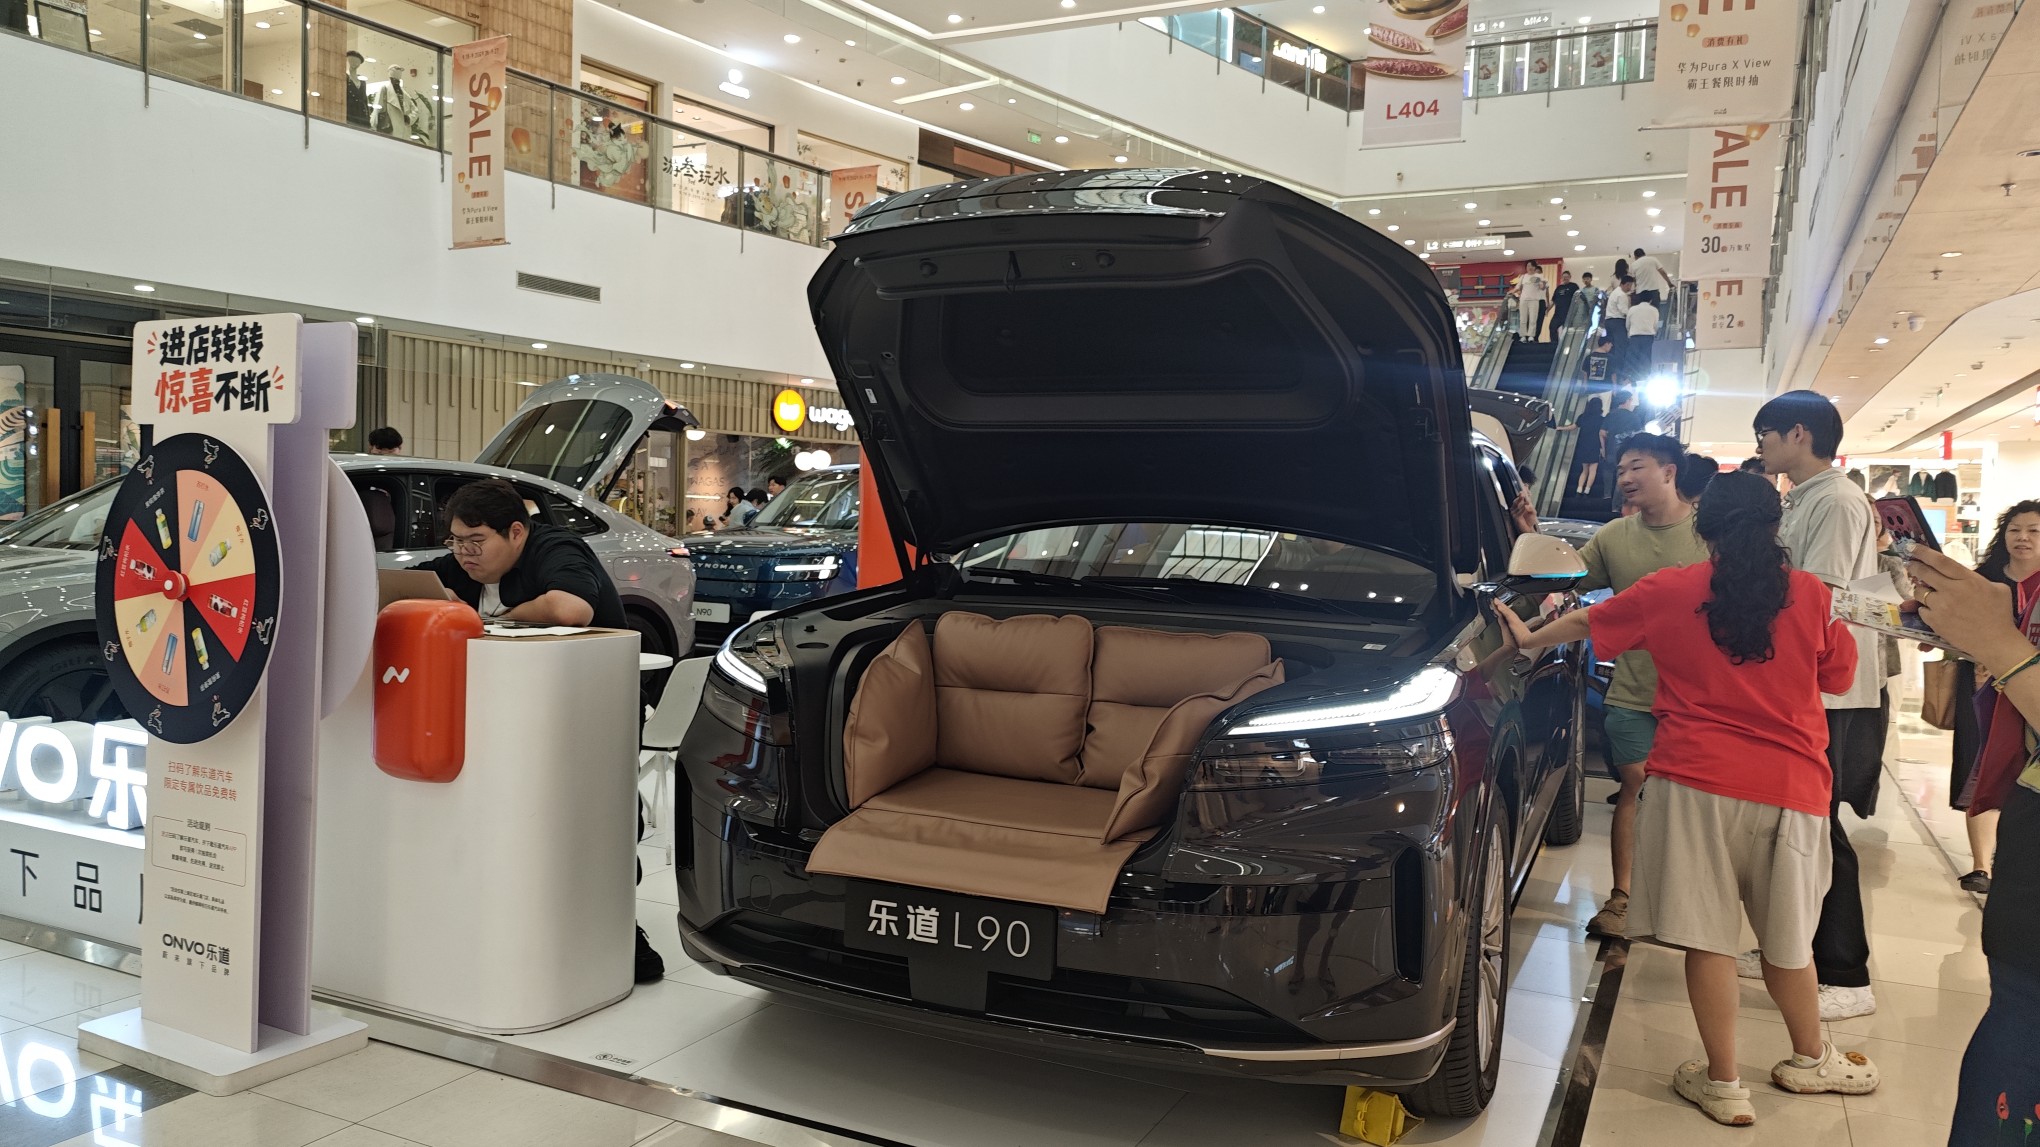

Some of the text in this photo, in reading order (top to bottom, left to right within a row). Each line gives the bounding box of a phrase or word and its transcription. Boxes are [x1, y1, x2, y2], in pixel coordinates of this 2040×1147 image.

[1732, 60, 1740, 70] X
[1744, 58, 1772, 68] View
[1686, 75, 1760, 91] 霸王餐限时抽
[1385, 99, 1440, 121] L404
[469, 72, 492, 180] SALE
[1701, 236, 1721, 254] 30
[1726, 313, 1735, 329] 2
[159, 322, 265, 366] 进店转转
[154, 367, 272, 415] 惊喜不断
[696, 607, 713, 617] N90
[167, 760, 234, 784] 扫码了解乐道汽车
[163, 776, 238, 802] 限定专属饮品免费转
[10, 848, 144, 925] 下品
[867, 899, 1031, 958] 乐道 L90
